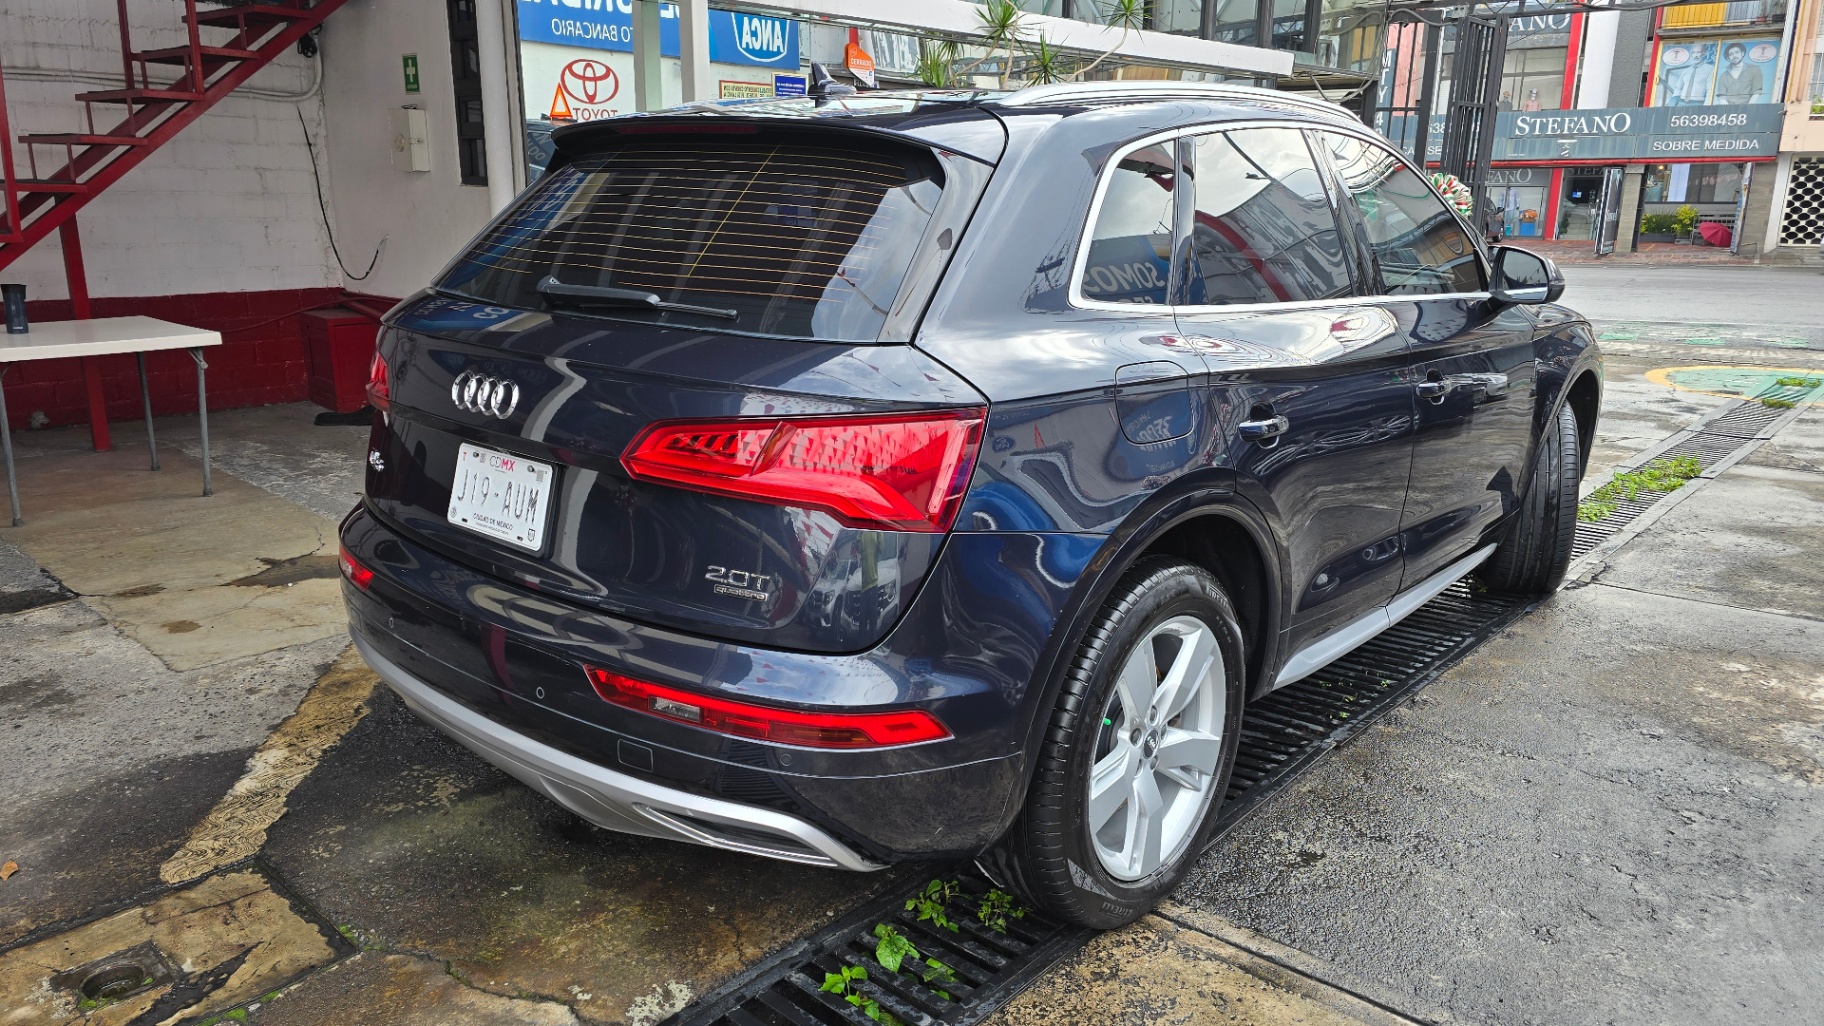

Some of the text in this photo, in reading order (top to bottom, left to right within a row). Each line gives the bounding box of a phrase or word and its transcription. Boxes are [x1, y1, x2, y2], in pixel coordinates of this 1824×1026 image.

[1509, 14, 1571, 32] ANO
[1515, 112, 1631, 136] STEFANO
[1670, 113, 1747, 128] 56398458
[1652, 139, 1760, 152] SOBRE MEDIDA
[489, 455, 516, 472] CDMX
[704, 565, 771, 590] 2.0T
